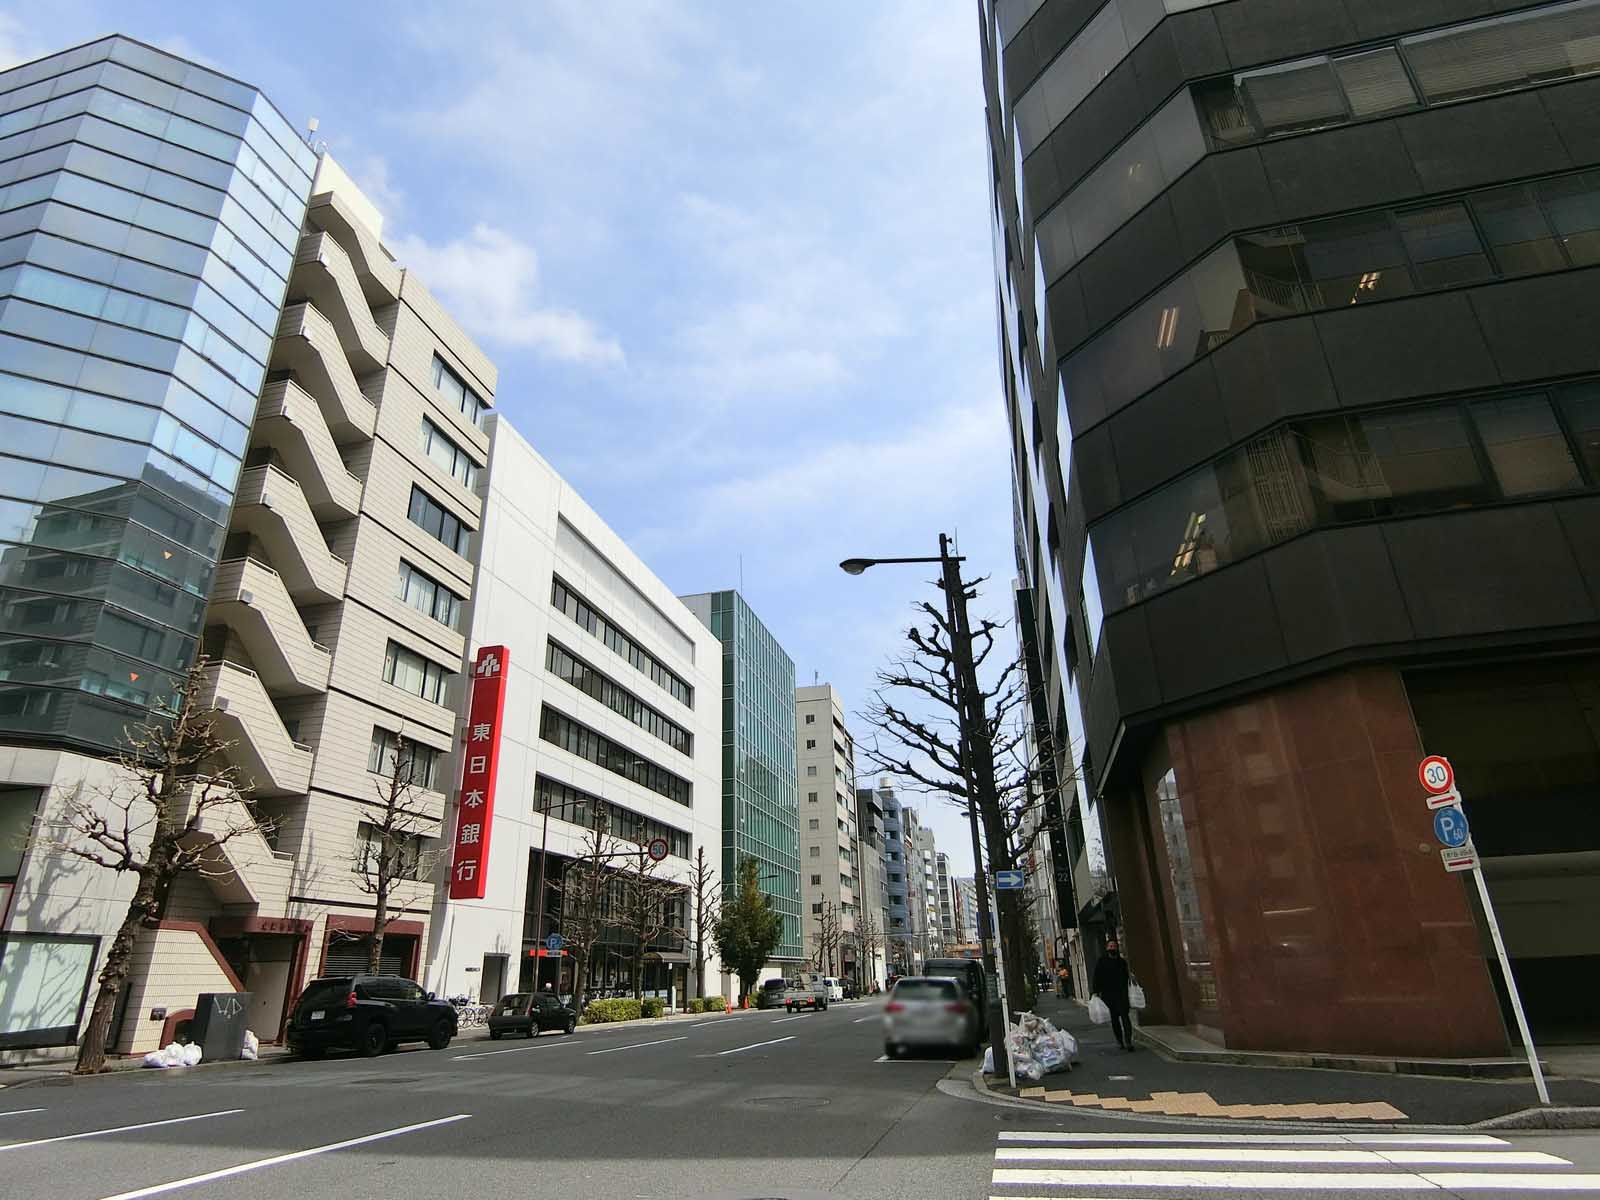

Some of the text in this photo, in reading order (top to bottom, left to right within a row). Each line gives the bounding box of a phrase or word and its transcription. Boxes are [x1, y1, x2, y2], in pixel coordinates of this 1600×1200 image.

[1427, 766, 1446, 784] 30
[457, 723, 491, 881] 東日本銀行
[1440, 817, 1454, 841] P
[1057, 872, 1069, 882] 22
